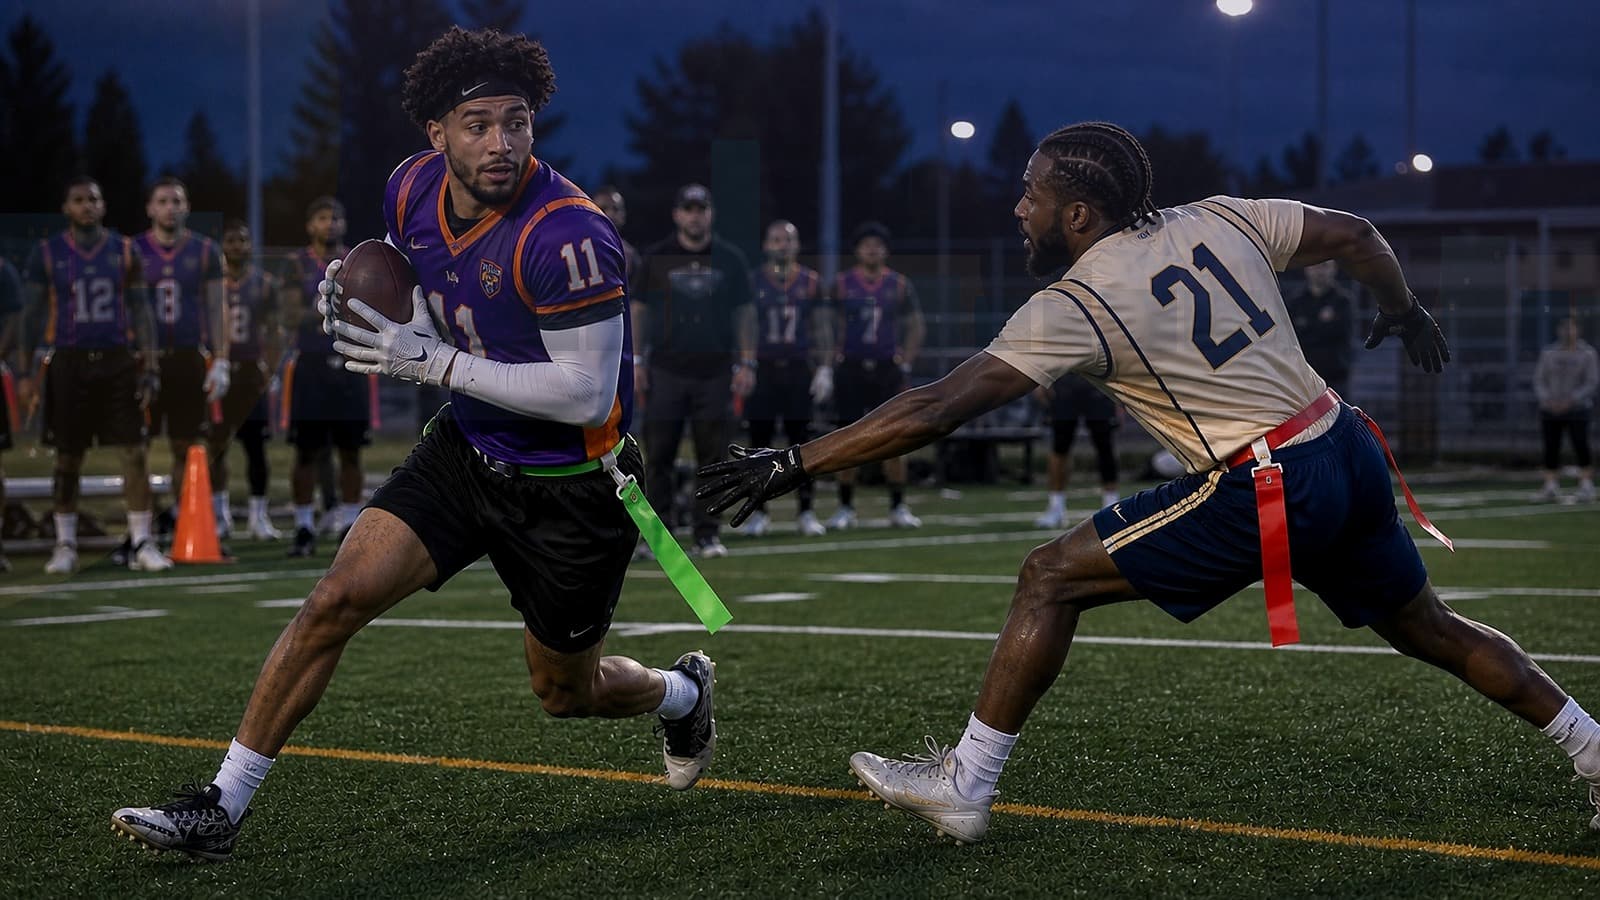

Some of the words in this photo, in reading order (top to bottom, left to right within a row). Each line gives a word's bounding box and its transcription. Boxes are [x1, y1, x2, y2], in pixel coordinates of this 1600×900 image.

[560, 237, 604, 293] 11
[73, 276, 115, 323] 12
[156, 278, 182, 324] 8
[1152, 243, 1275, 370] 21
[766, 304, 797, 344] 17
[861, 304, 883, 344] 7
